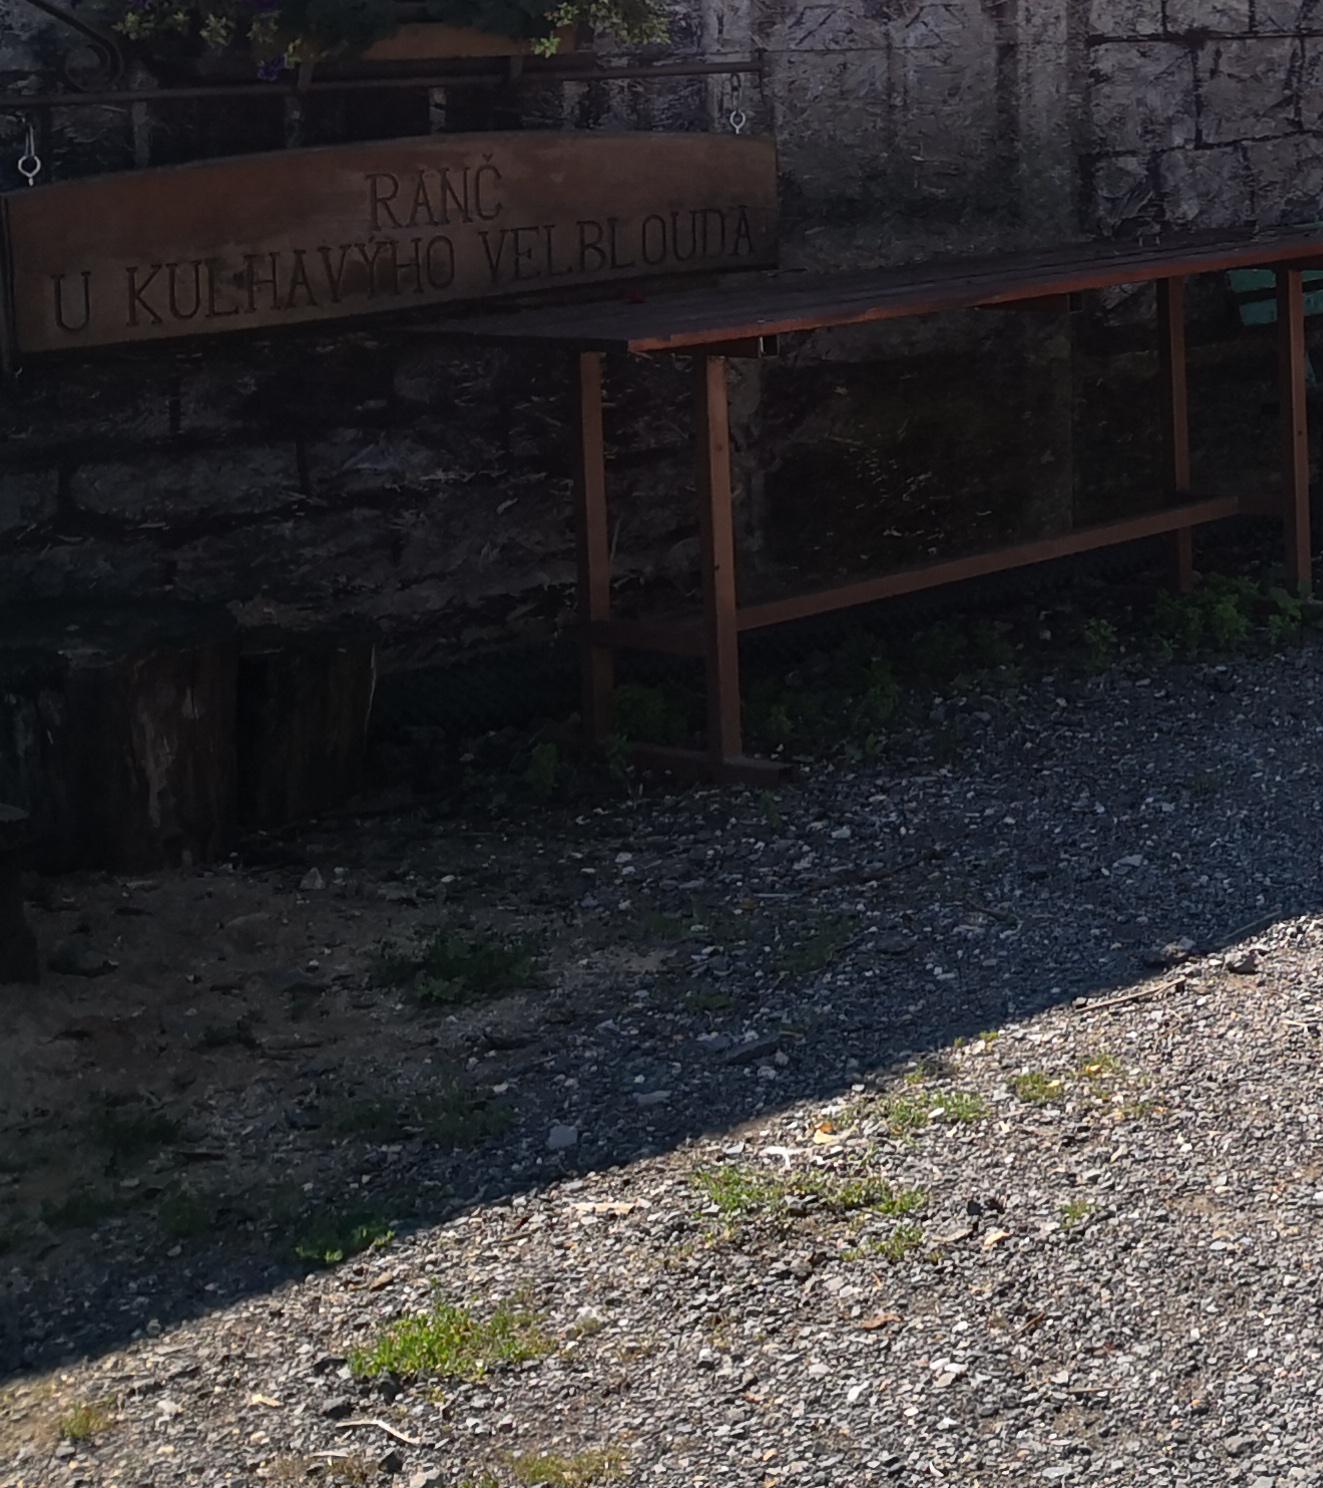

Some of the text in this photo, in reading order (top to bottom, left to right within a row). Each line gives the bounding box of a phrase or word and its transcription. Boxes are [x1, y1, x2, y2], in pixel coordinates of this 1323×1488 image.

[366, 154, 503, 232] RANČ
[51, 204, 757, 333] U KULHAVÝHO VELBLOUDA
